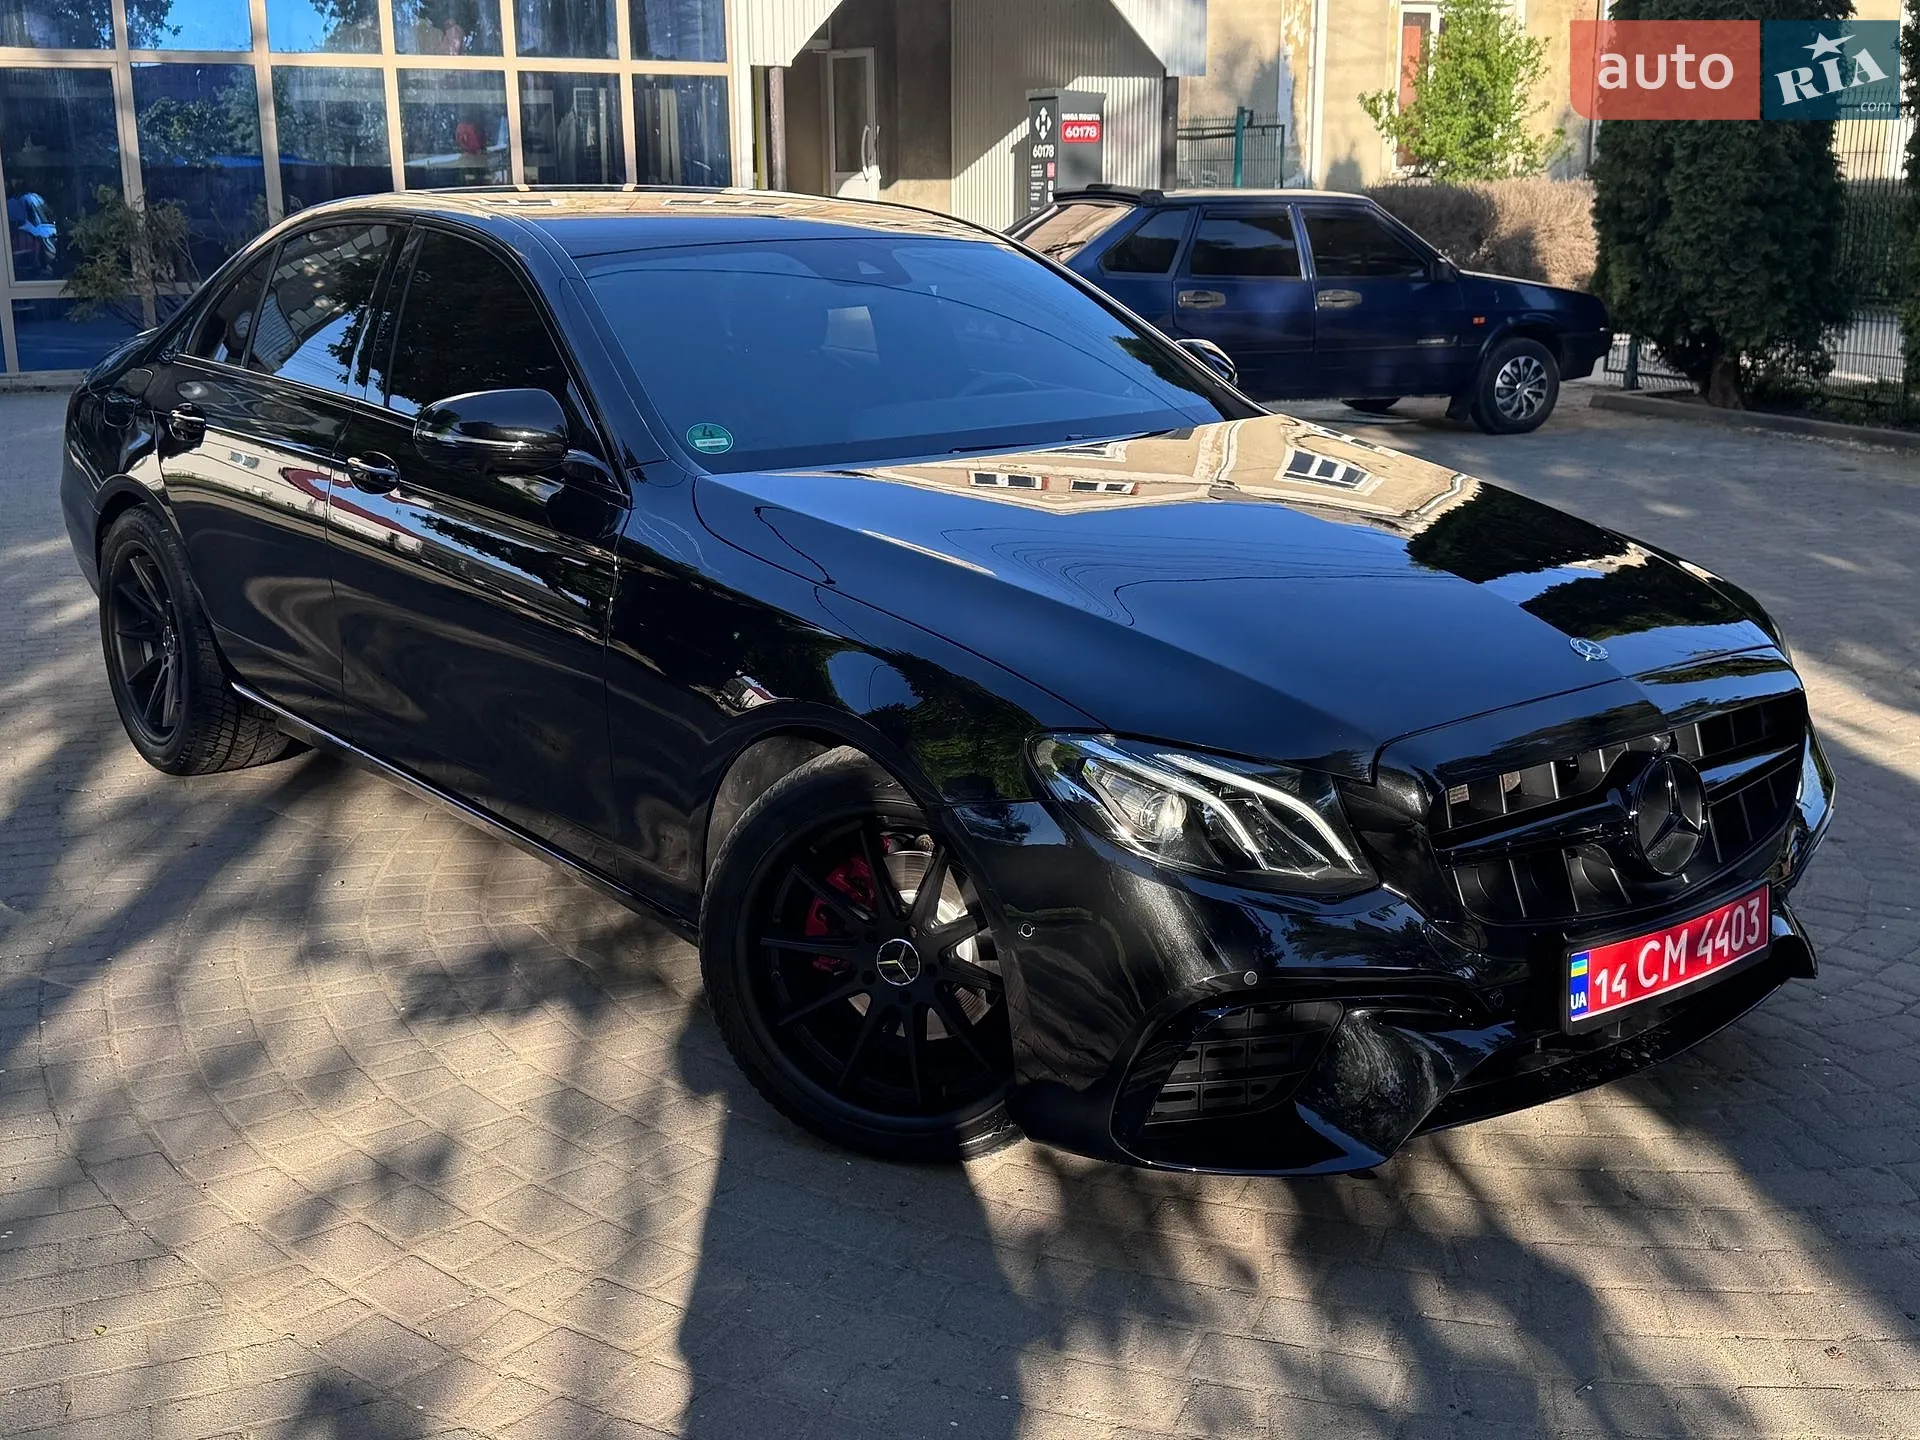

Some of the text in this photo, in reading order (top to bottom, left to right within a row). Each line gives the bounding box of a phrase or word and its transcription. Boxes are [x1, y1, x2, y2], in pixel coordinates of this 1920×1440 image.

[1065, 125, 1097, 138] 60178
[1032, 144, 1055, 158] 60178
[1594, 896, 1761, 1004] 14 CM 4403
[1570, 992, 1587, 1009] UA
